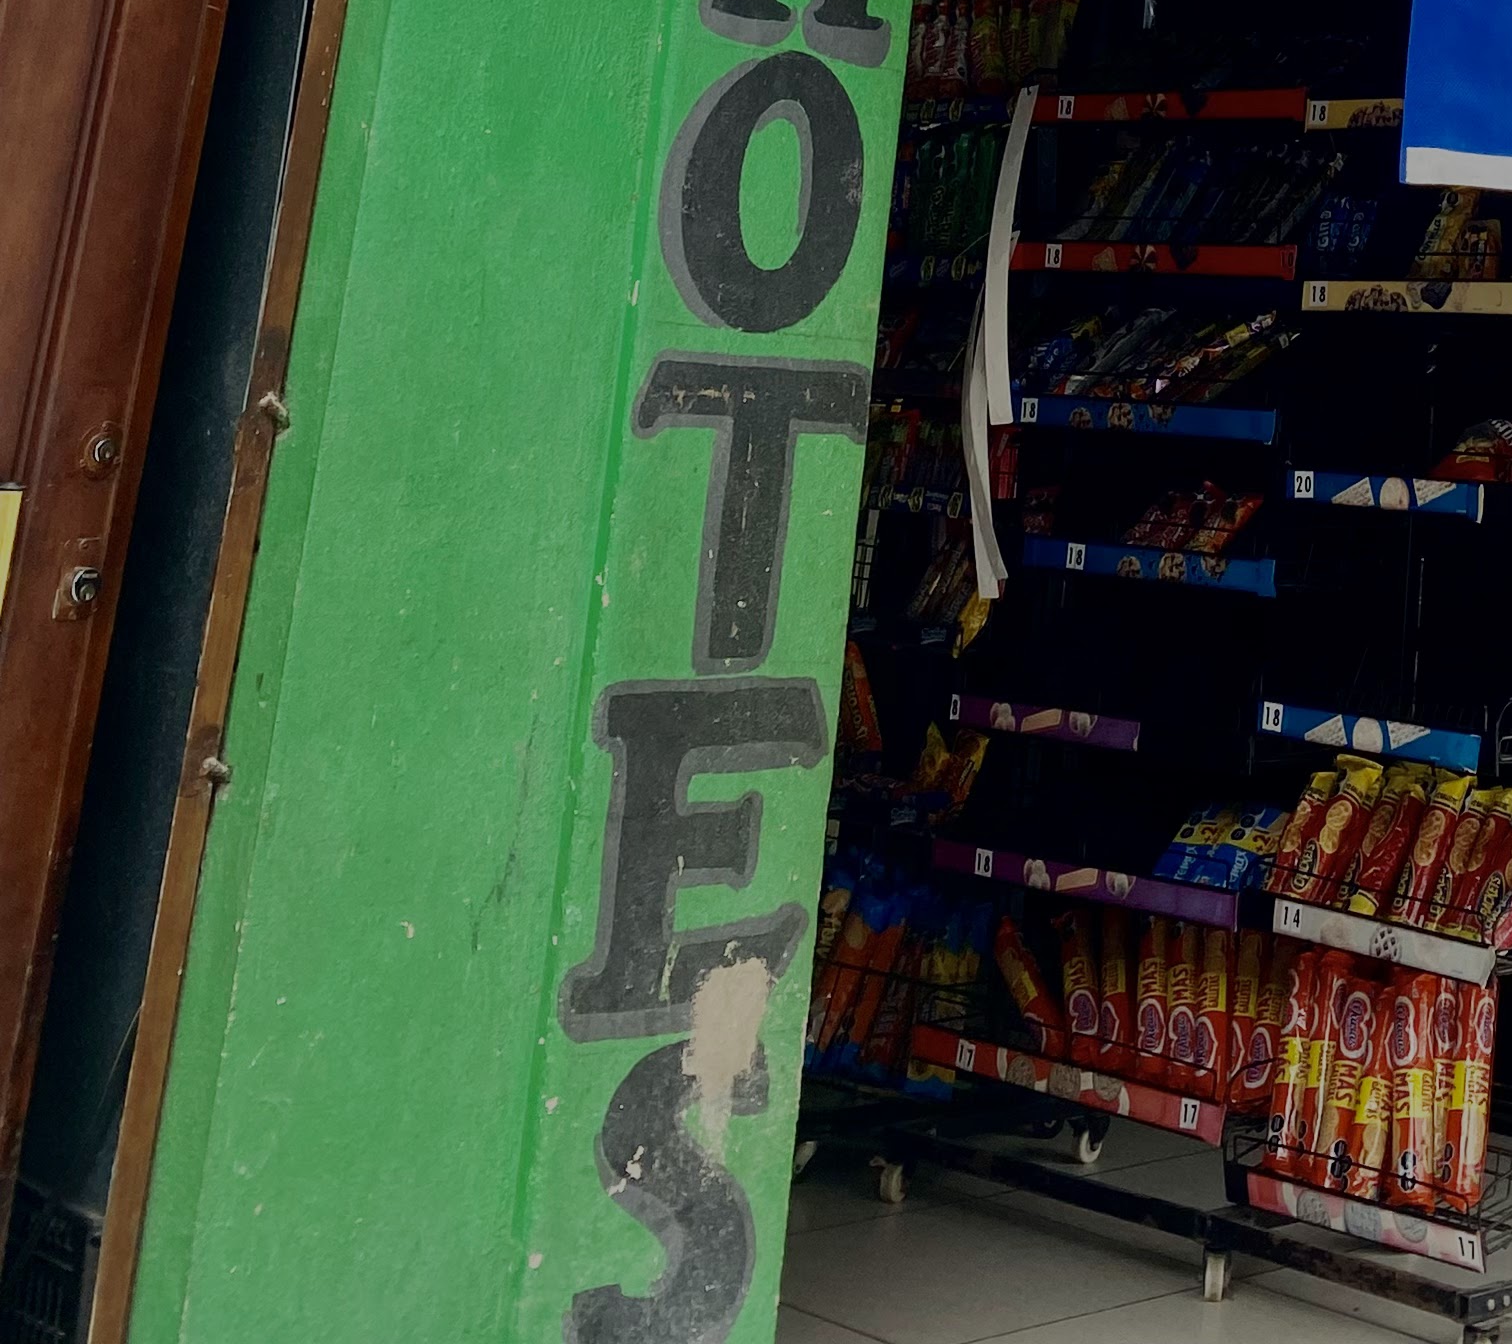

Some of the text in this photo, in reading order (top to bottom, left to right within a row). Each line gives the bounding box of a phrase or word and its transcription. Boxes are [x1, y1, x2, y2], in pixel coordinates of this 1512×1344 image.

[1059, 100, 1073, 115] 18
[1312, 103, 1327, 122] 18
[1047, 248, 1061, 265] 18
[1312, 285, 1327, 303] 18
[1023, 401, 1036, 419] 18
[1295, 475, 1312, 494] 20
[1068, 547, 1083, 566] 18
[1265, 707, 1281, 728] 18
[977, 853, 990, 873] 18
[1283, 906, 1300, 928] 14
[957, 1045, 972, 1066] 17
[1182, 1103, 1198, 1123] 17
[1456, 1235, 1476, 1260] 17
